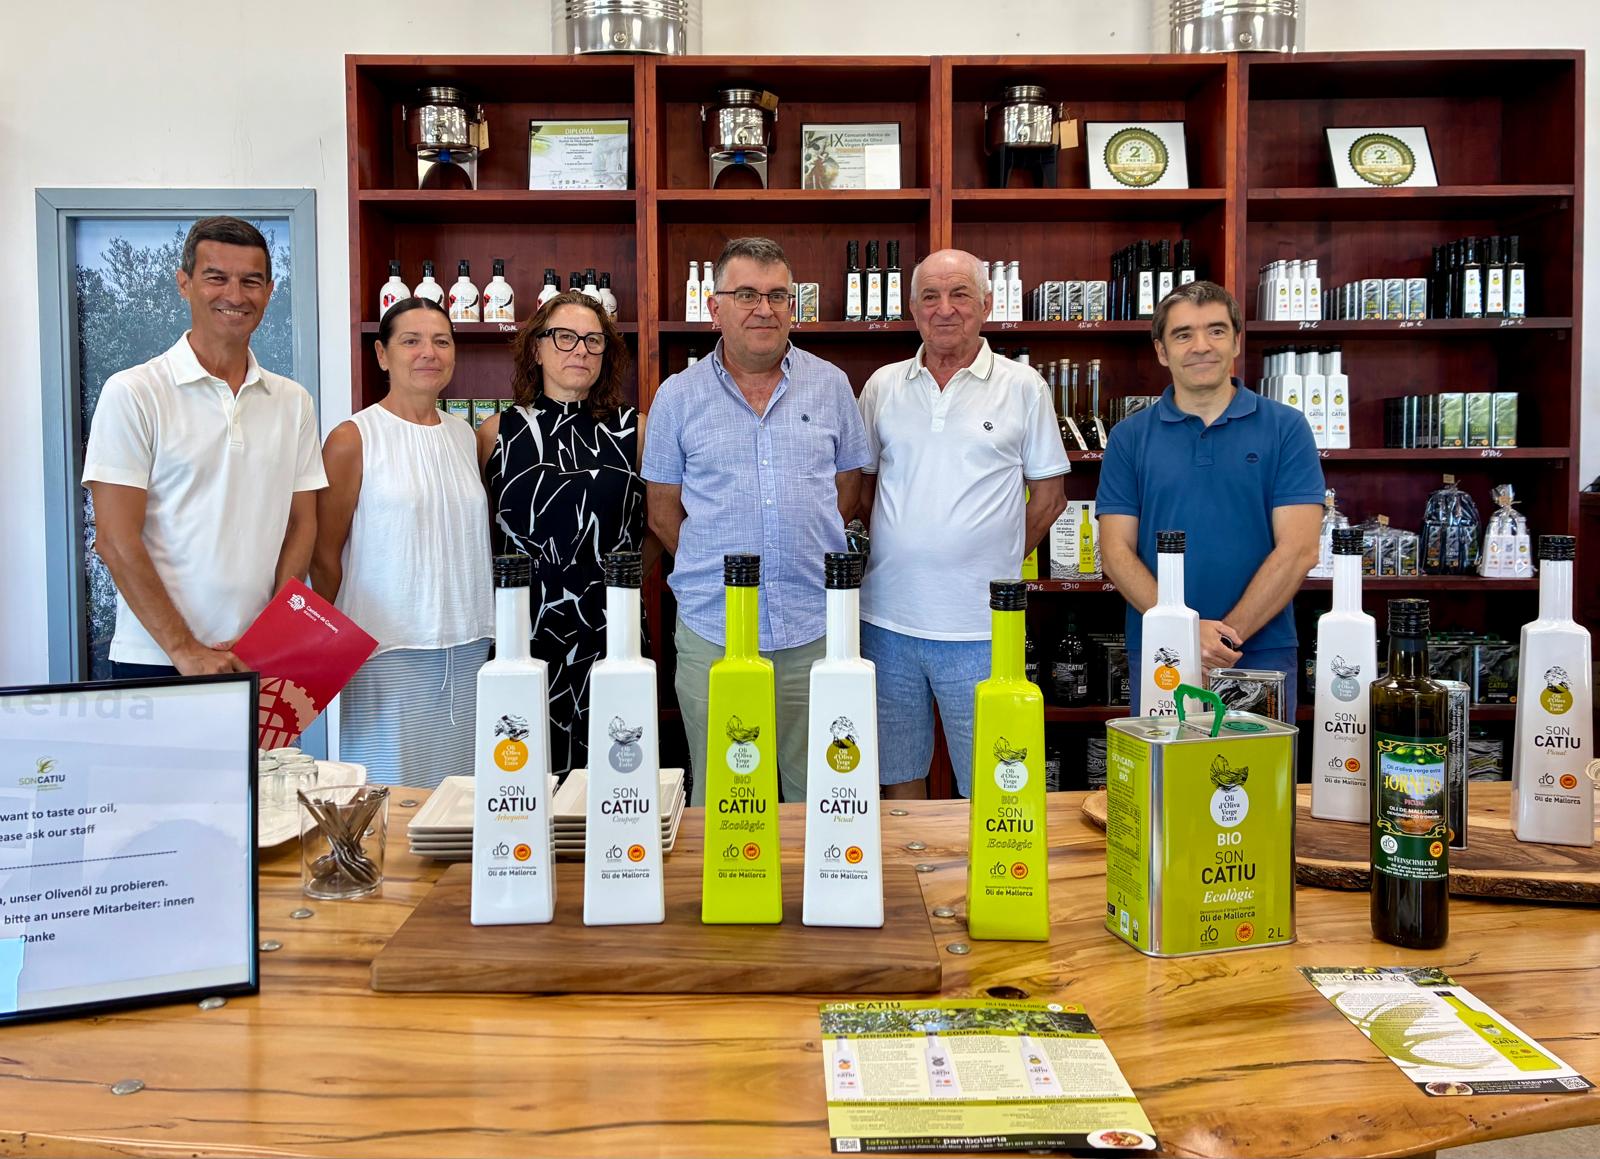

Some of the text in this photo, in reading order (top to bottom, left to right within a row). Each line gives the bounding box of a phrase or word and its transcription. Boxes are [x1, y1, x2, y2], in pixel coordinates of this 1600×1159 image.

[830, 133, 844, 147] IX
[1335, 712, 1357, 722] SON
[1324, 721, 1366, 735] CATIU
[1545, 725, 1570, 736] SON
[1534, 735, 1581, 749] CATIU
[499, 785, 525, 796] SON
[612, 787, 639, 799] SON
[730, 787, 755, 798] SON
[831, 787, 857, 798] SON
[488, 797, 536, 812] CATIU
[601, 800, 650, 814] CATIU
[718, 799, 766, 814] CATIU
[820, 799, 868, 814] CATIU
[1218, 801, 1240, 809] d'Oliva
[1554, 797, 1581, 805] Mallorca
[0, 803, 117, 822] want to taste our oil,
[997, 807, 1023, 818] SON
[1221, 809, 1238, 817] Verge
[833, 815, 854, 823] Picual
[25, 828, 45, 840] ask
[47, 828, 66, 838] our
[70, 824, 96, 837] staff
[719, 820, 766, 833] Ecològic
[986, 819, 1034, 833] CATIU
[986, 838, 1033, 851] Ecològic
[1217, 831, 1242, 847] BIO
[1215, 849, 1244, 865] SON
[488, 869, 498, 877] Oli
[622, 871, 650, 879] Mallorca
[738, 871, 766, 879] Mallorca
[840, 872, 868, 880] Mallorca
[1201, 863, 1256, 885] CATIU
[10, 892, 42, 905] unser
[45, 885, 92, 901] Olivenöl
[95, 886, 108, 896] zu
[110, 878, 169, 895] probieren.
[985, 888, 1033, 897] Oli de Mallorca
[1203, 886, 1255, 904] Ecològic
[4, 895, 195, 926] bitte an unsere Mitarbeiter: innen
[1200, 911, 1256, 923] Oli de Mallorca
[19, 931, 56, 944] Danke
[1268, 927, 1284, 939] 2 L
[825, 1001, 901, 1011] SONCATIU
